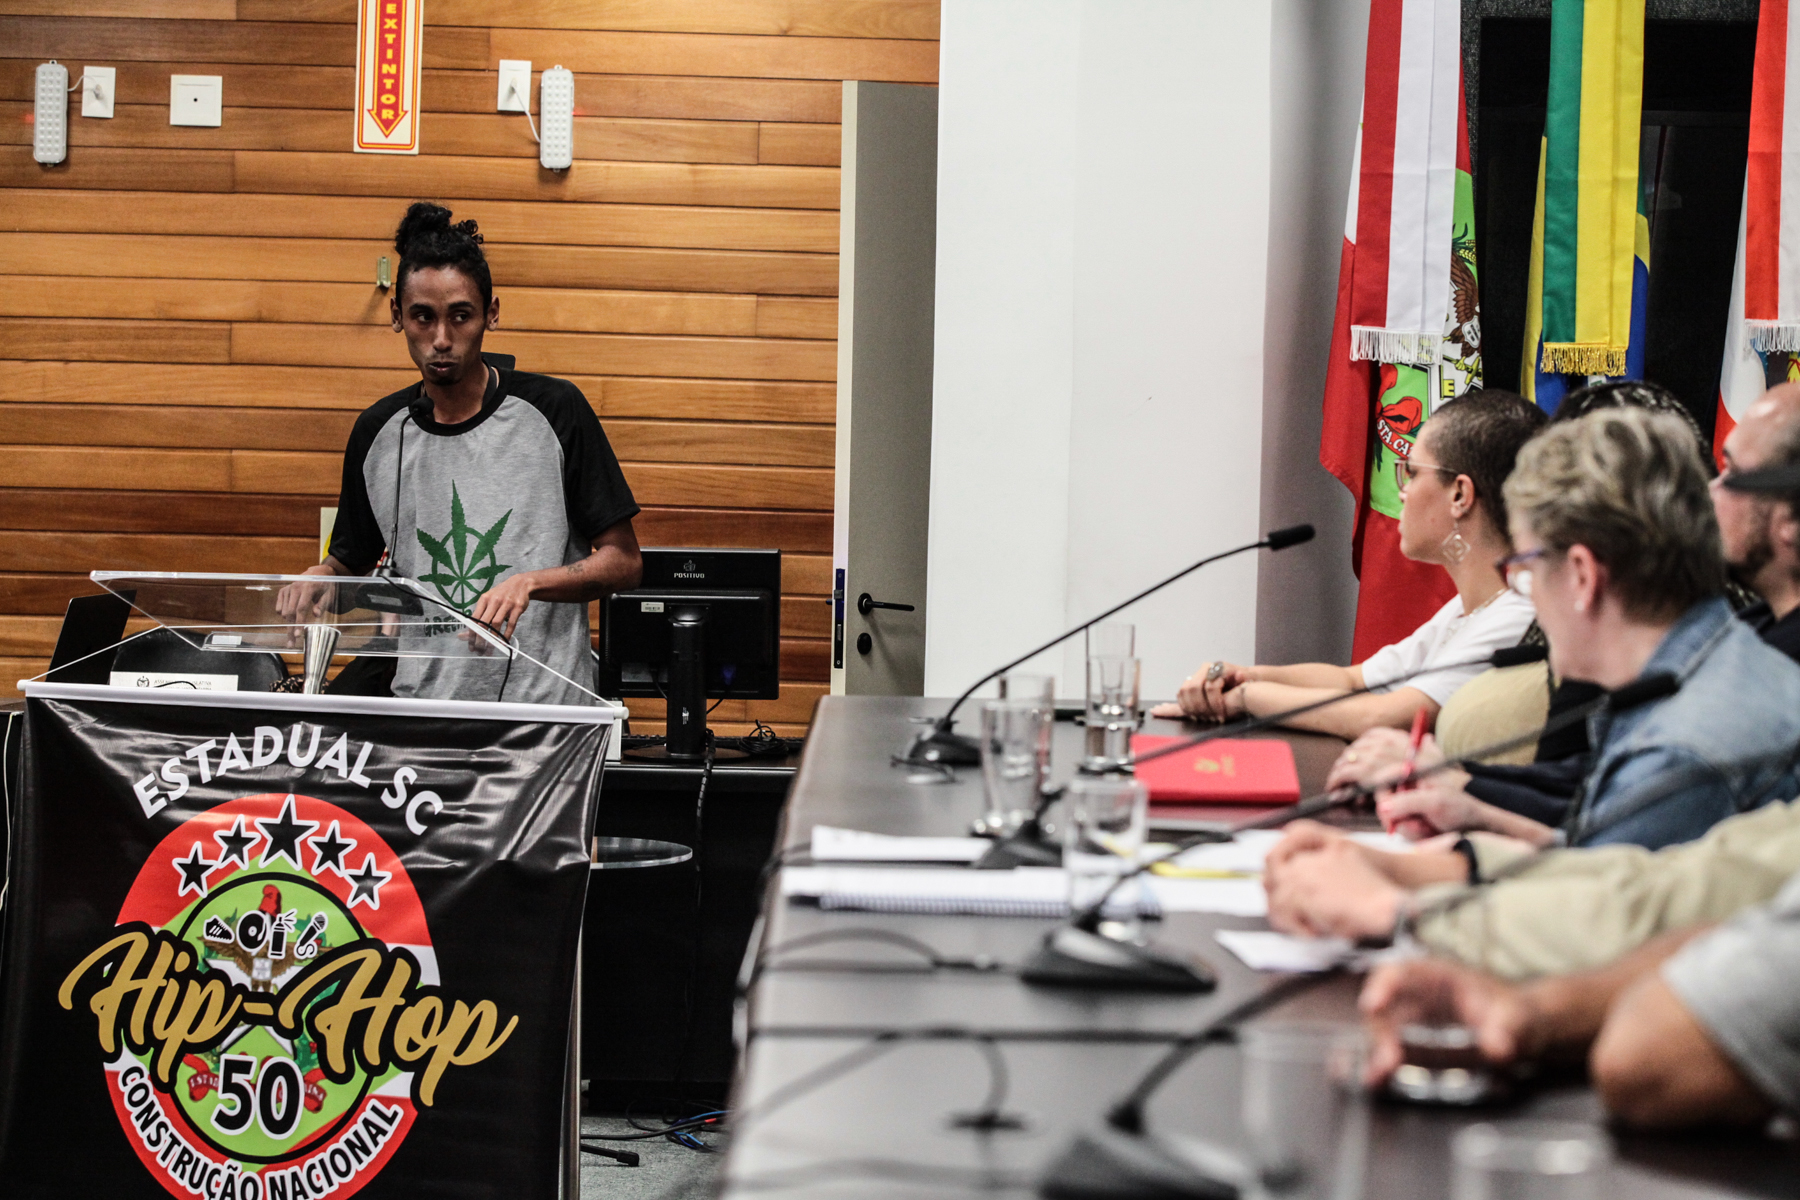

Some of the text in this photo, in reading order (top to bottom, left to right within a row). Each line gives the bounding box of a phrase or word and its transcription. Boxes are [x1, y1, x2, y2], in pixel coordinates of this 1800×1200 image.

[380, 3, 398, 120] EXTINTOR
[132, 724, 444, 836] ESTADUAL SC
[57, 931, 520, 1107] Hip-Hop
[121, 1065, 399, 1200] CONSTRUÇÃO NACIONAL
[211, 1055, 304, 1138] 50
